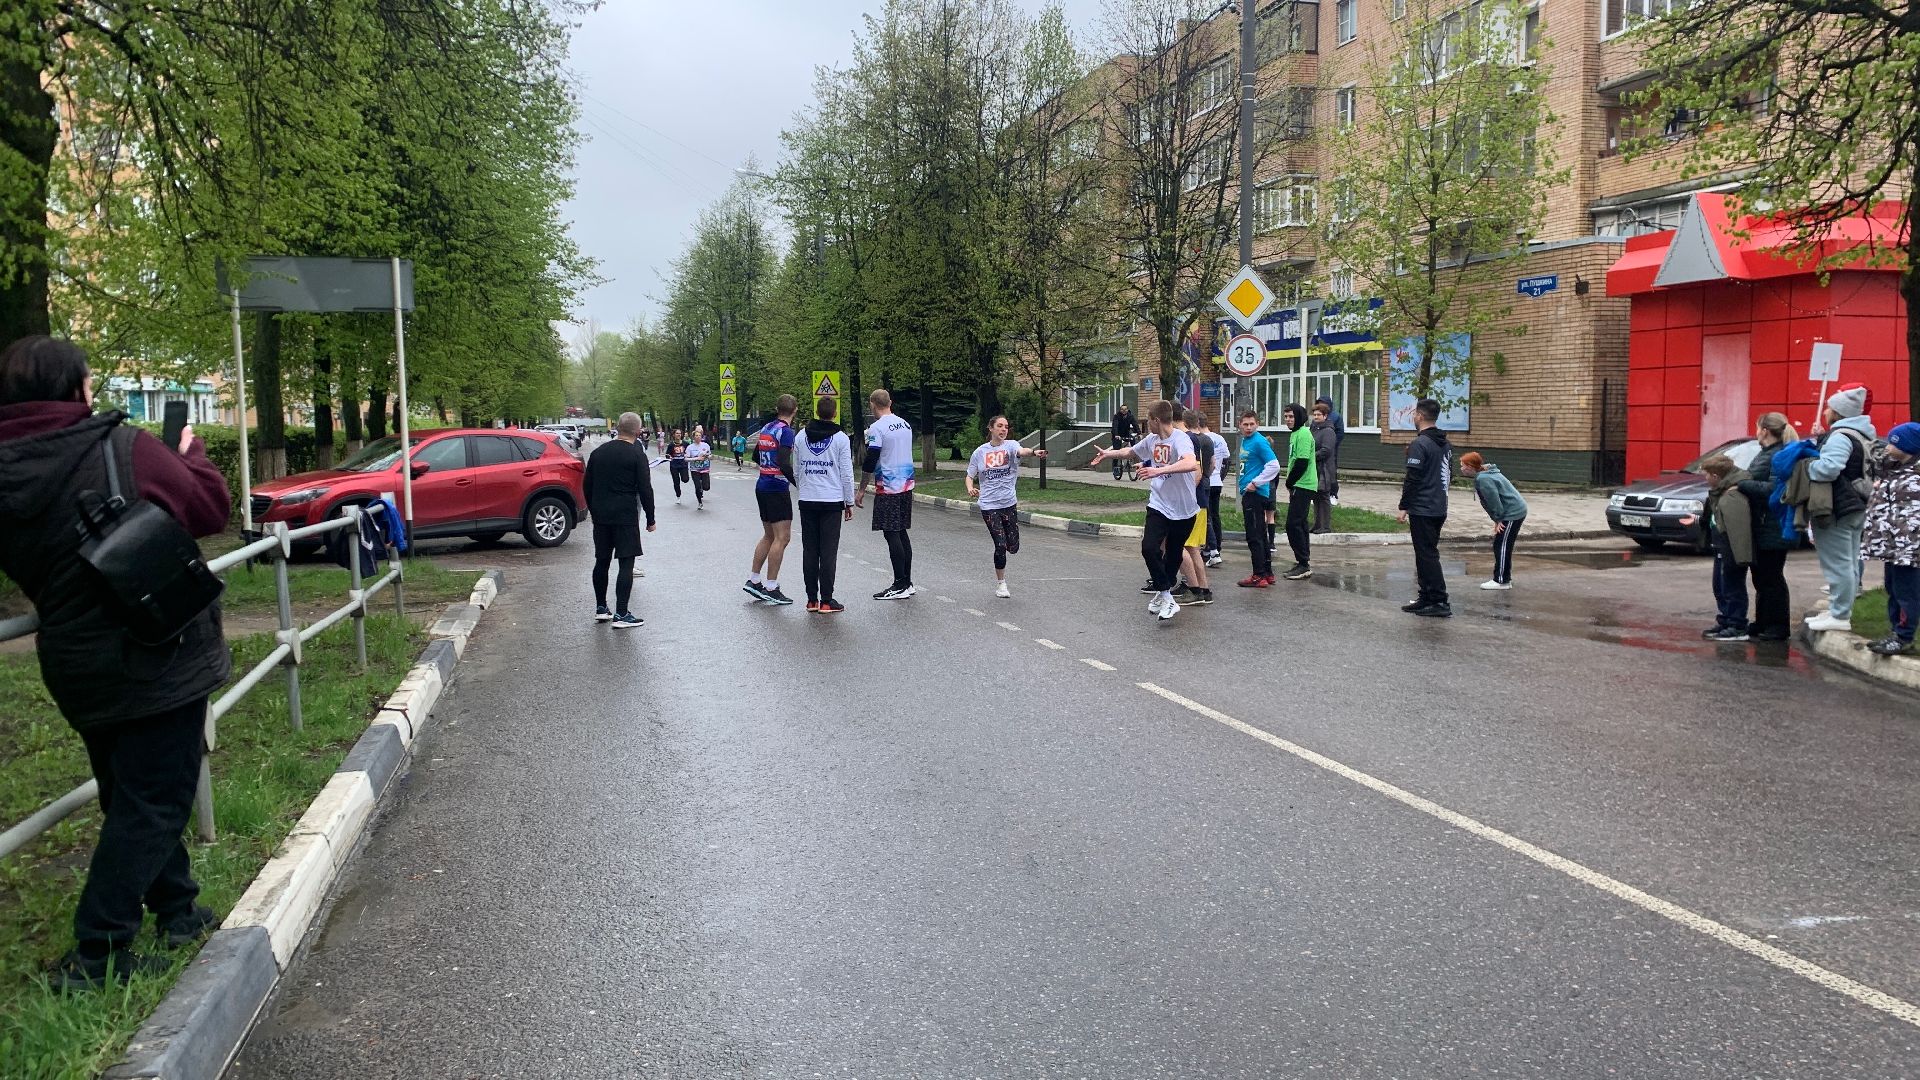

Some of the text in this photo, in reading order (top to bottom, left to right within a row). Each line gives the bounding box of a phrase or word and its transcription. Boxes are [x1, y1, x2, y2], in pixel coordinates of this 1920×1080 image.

[1530, 278, 1552, 287] ПУШКИНА
[1533, 287, 1541, 296] 21
[986, 451, 1005, 468] 30
[1154, 445, 1169, 464] 30
